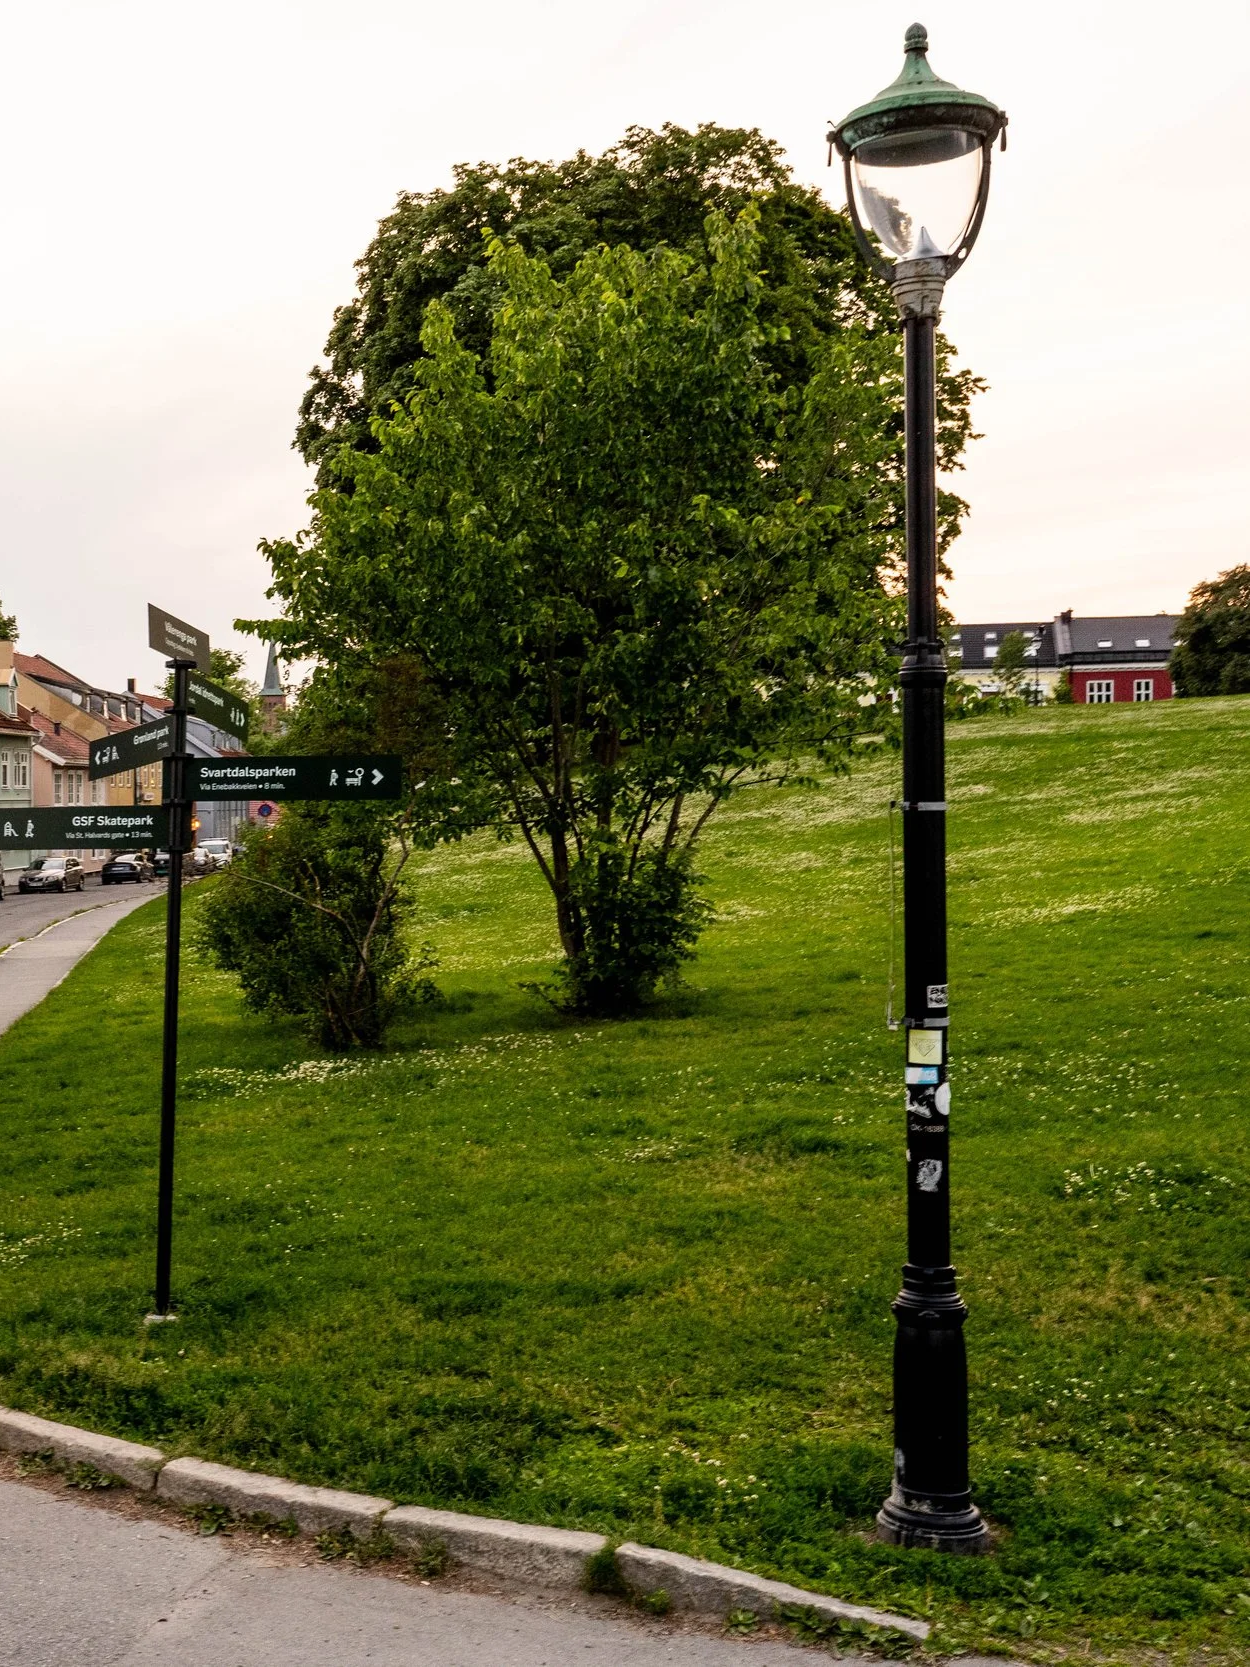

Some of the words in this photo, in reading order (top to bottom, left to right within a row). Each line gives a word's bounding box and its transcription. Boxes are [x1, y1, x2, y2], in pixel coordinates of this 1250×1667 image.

[157, 725, 170, 741] park
[200, 766, 296, 779] Svartdalsparken
[264, 782, 270, 790] 8
[270, 782, 286, 790] min.
[72, 816, 95, 826] GSF
[96, 815, 154, 828] Skatepark
